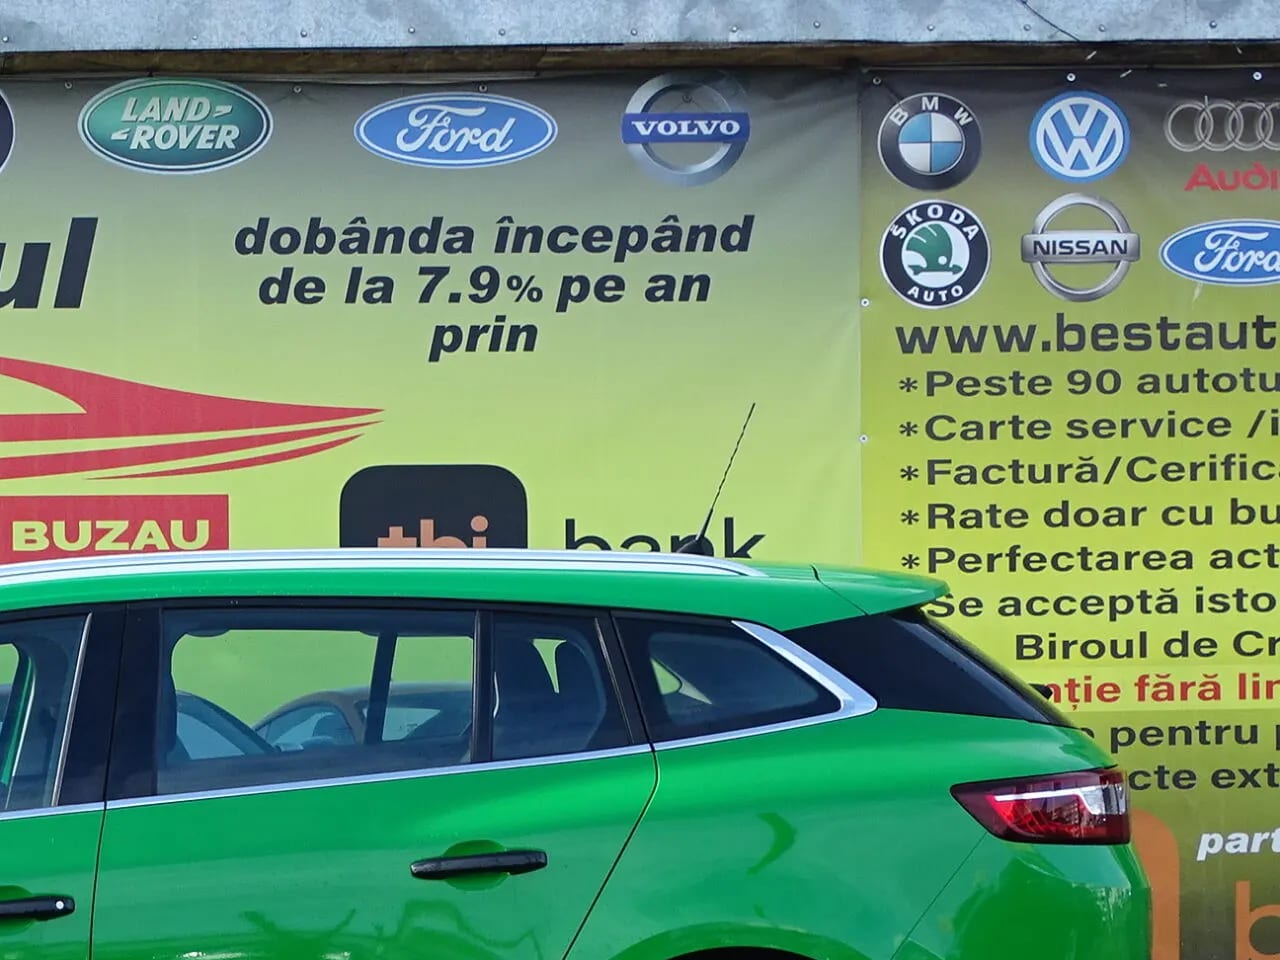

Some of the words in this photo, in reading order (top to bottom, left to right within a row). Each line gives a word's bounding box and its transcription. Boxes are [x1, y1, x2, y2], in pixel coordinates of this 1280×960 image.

[890, 96, 974, 126] BMW
[396, 104, 515, 154] Ford
[631, 118, 741, 137] VOLVO
[235, 216, 475, 256] dobânda
[494, 214, 755, 263] începând
[1033, 239, 1127, 256] NISSAN
[259, 267, 325, 304] de
[345, 267, 394, 304] la
[556, 273, 626, 312] pe
[645, 272, 711, 302] an
[907, 284, 964, 303] AUTO
[428, 315, 539, 362] prin
[896, 313, 1277, 354] www.bestaut
[1067, 369, 1122, 395] 90
[1137, 368, 1280, 395] autotu
[1066, 409, 1233, 440] service
[900, 454, 1280, 486] Factură/Cerific
[1043, 500, 1148, 528] doar
[1161, 504, 1213, 526] cu
[12, 519, 211, 552] BUZAU
[998, 587, 1179, 622] acceptă
[1195, 586, 1277, 614] isto
[1016, 631, 1149, 661] Biroul
[1164, 630, 1218, 658] de
[1134, 672, 1222, 703] fără
[1110, 721, 1259, 753] pentru
[1211, 763, 1280, 789] ext
